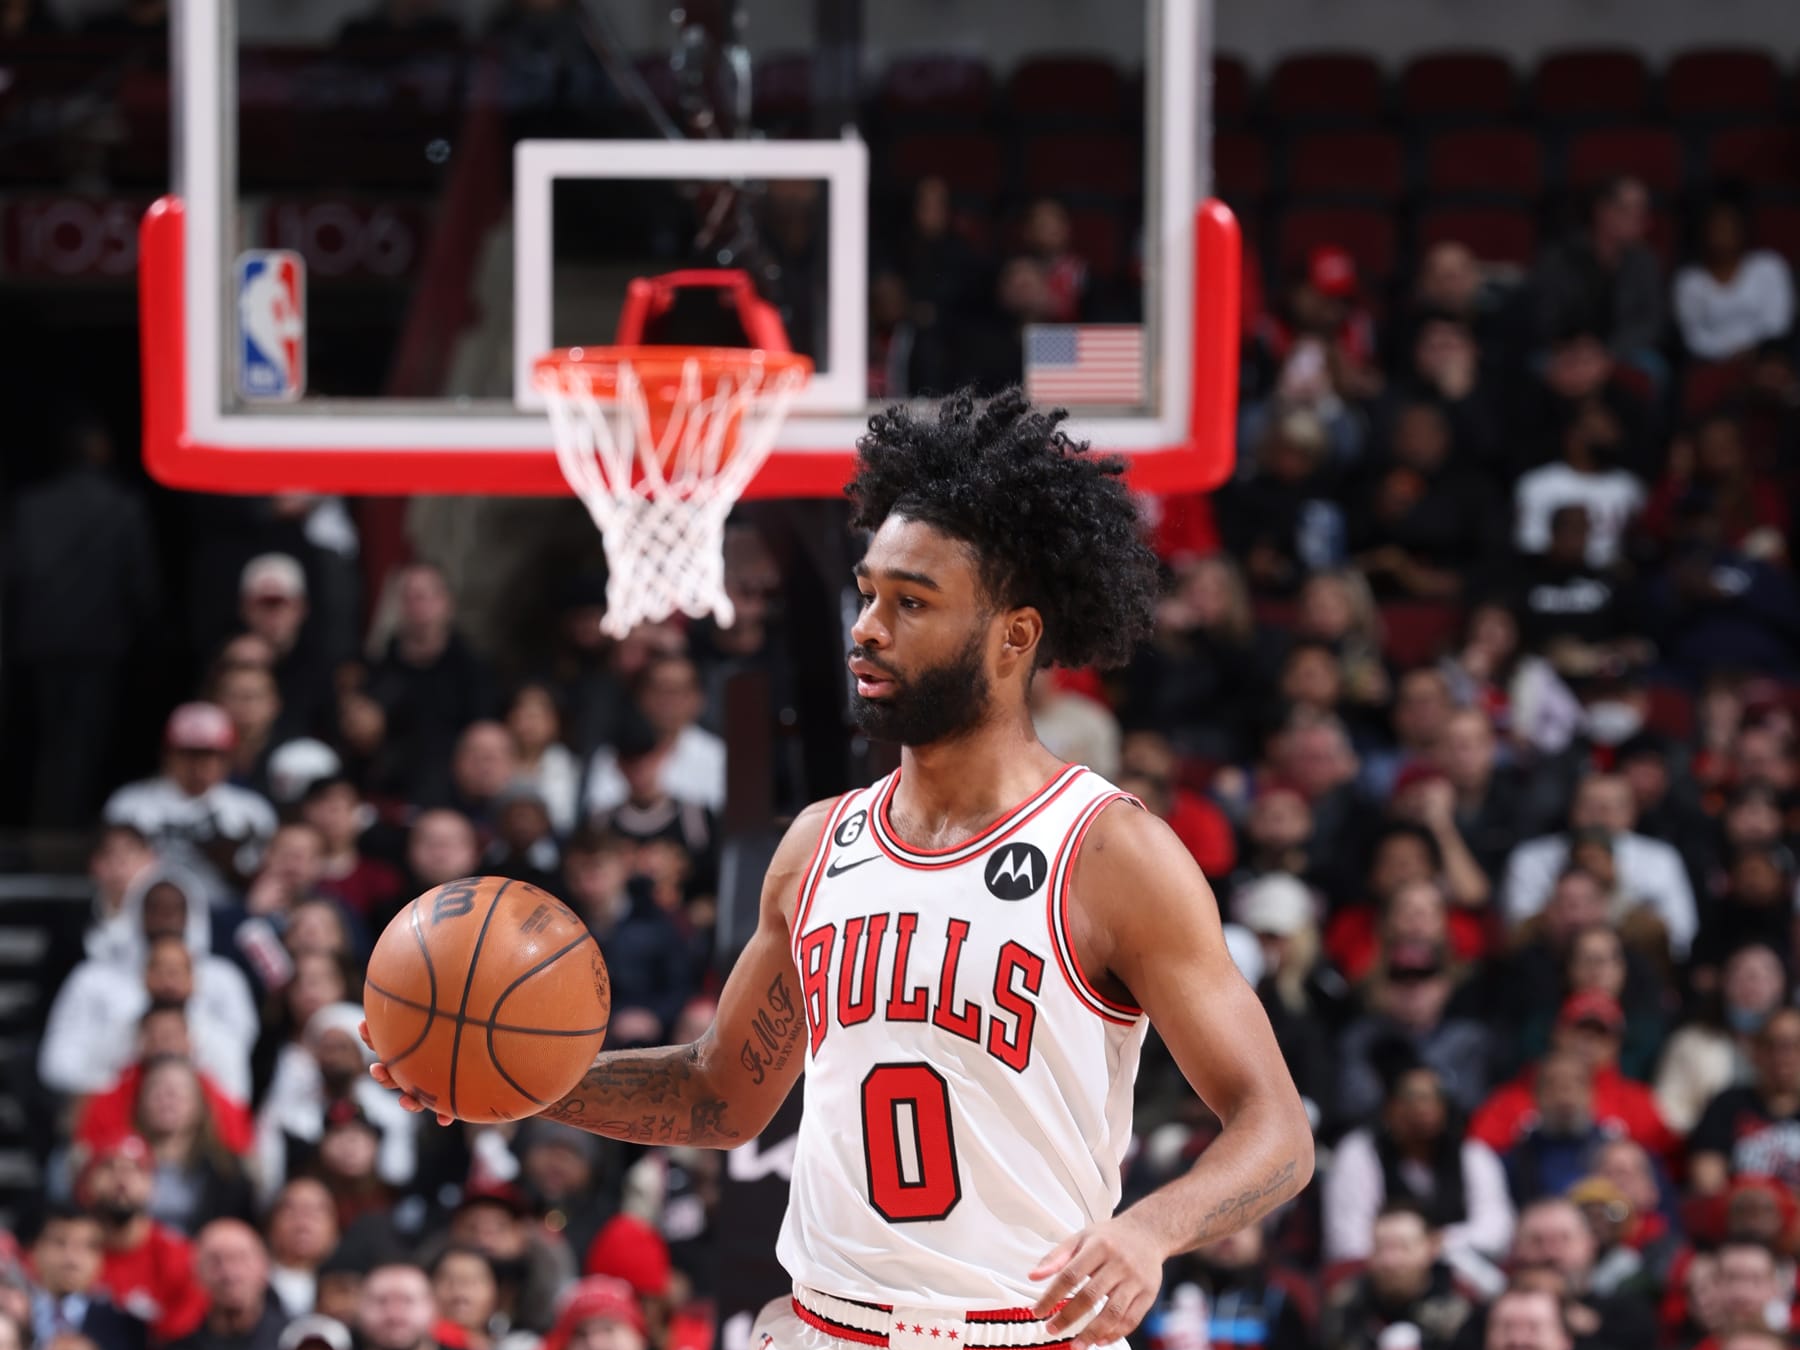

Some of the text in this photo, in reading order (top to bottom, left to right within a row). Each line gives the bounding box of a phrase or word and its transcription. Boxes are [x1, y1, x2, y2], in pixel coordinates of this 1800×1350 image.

[840, 814, 863, 845] 6
[800, 911, 1045, 1074] BULLS
[860, 1060, 962, 1224] 0
